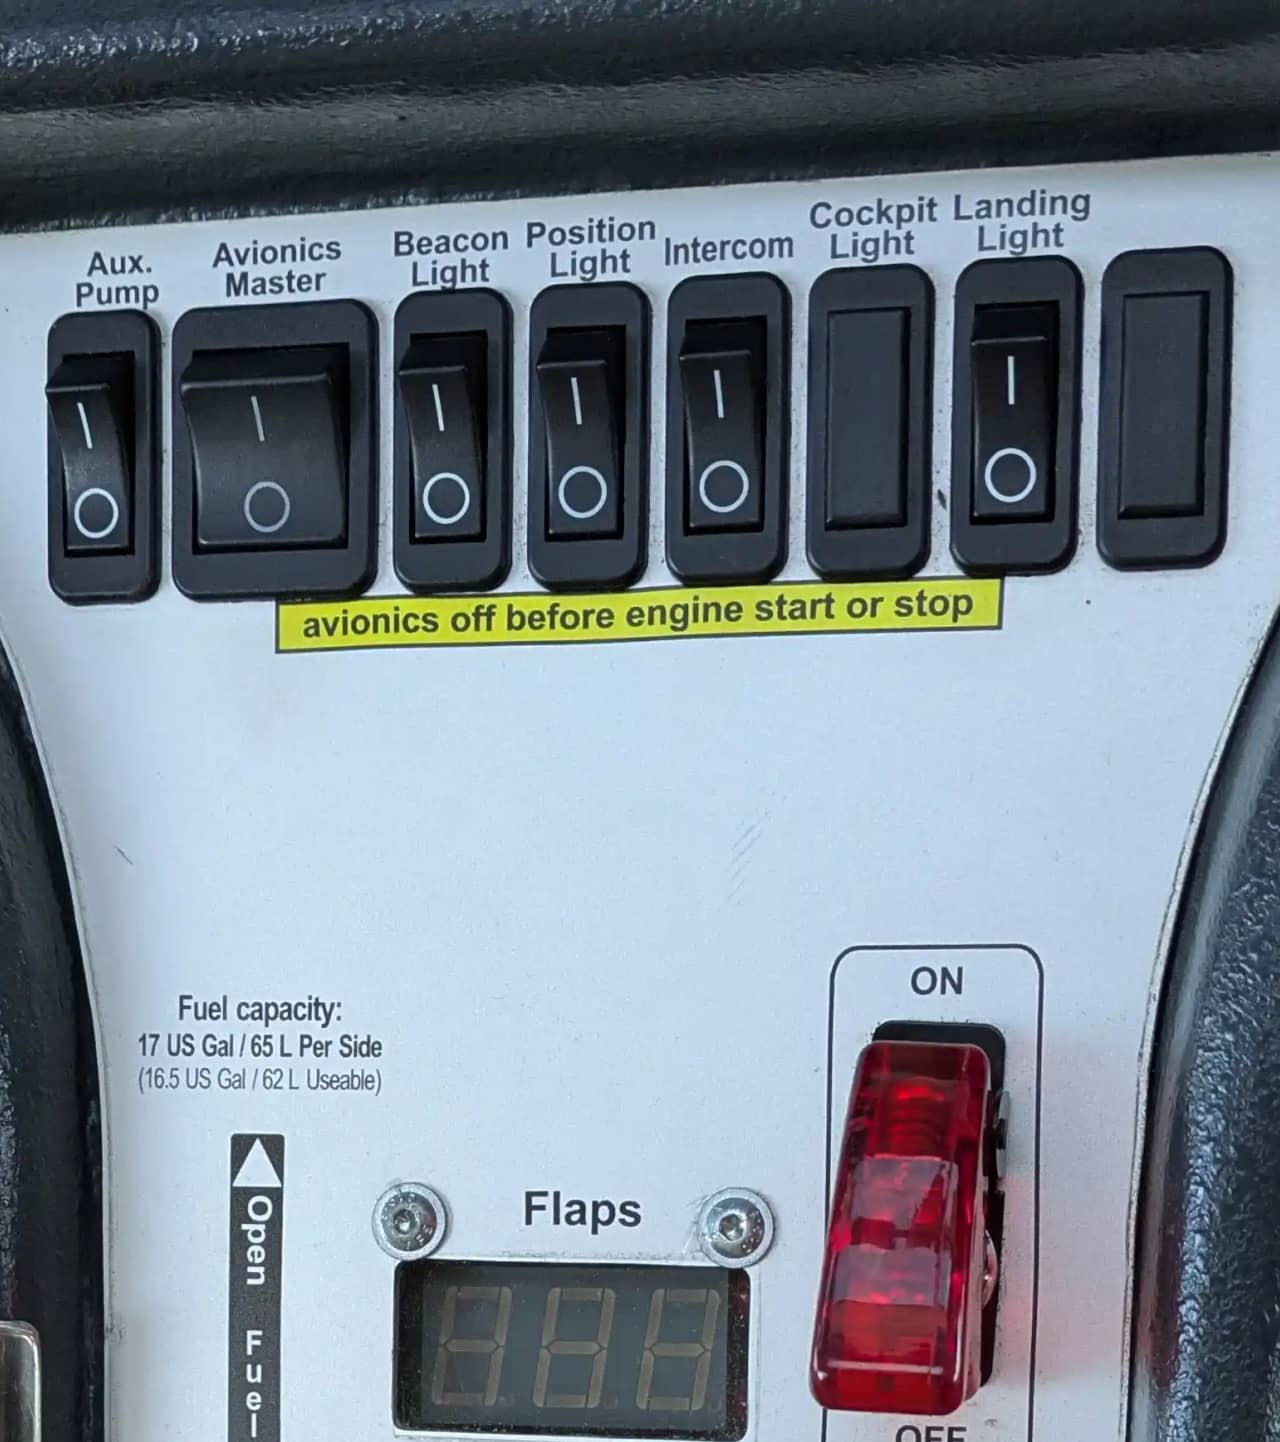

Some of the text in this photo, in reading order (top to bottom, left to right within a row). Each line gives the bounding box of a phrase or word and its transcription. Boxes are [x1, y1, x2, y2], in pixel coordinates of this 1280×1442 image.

[809, 196, 938, 232] Cockpit
[954, 189, 1091, 223] Landing
[394, 229, 509, 257] Beacon
[526, 218, 656, 249] Position
[664, 232, 794, 266] Intercom
[830, 229, 915, 264] Light
[977, 222, 1065, 257] Light
[87, 251, 152, 277] Aux.
[213, 239, 342, 268] Avionics
[549, 247, 631, 281] Light
[225, 269, 327, 298] Master
[412, 258, 490, 290] Light
[75, 281, 159, 312] Pump
[303, 589, 974, 638] avionics off before engine start or stop
[910, 966, 964, 995] ON
[178, 995, 342, 1028] Fuel capacity:
[138, 1033, 383, 1058] 17 US Gal / 65 L Per Side
[138, 1066, 382, 1096] (16.5 US Gal / 62 L Useable)
[523, 1191, 642, 1234] Flaps
[241, 1195, 273, 1286] Open
[246, 1329, 263, 1438] Fuel
